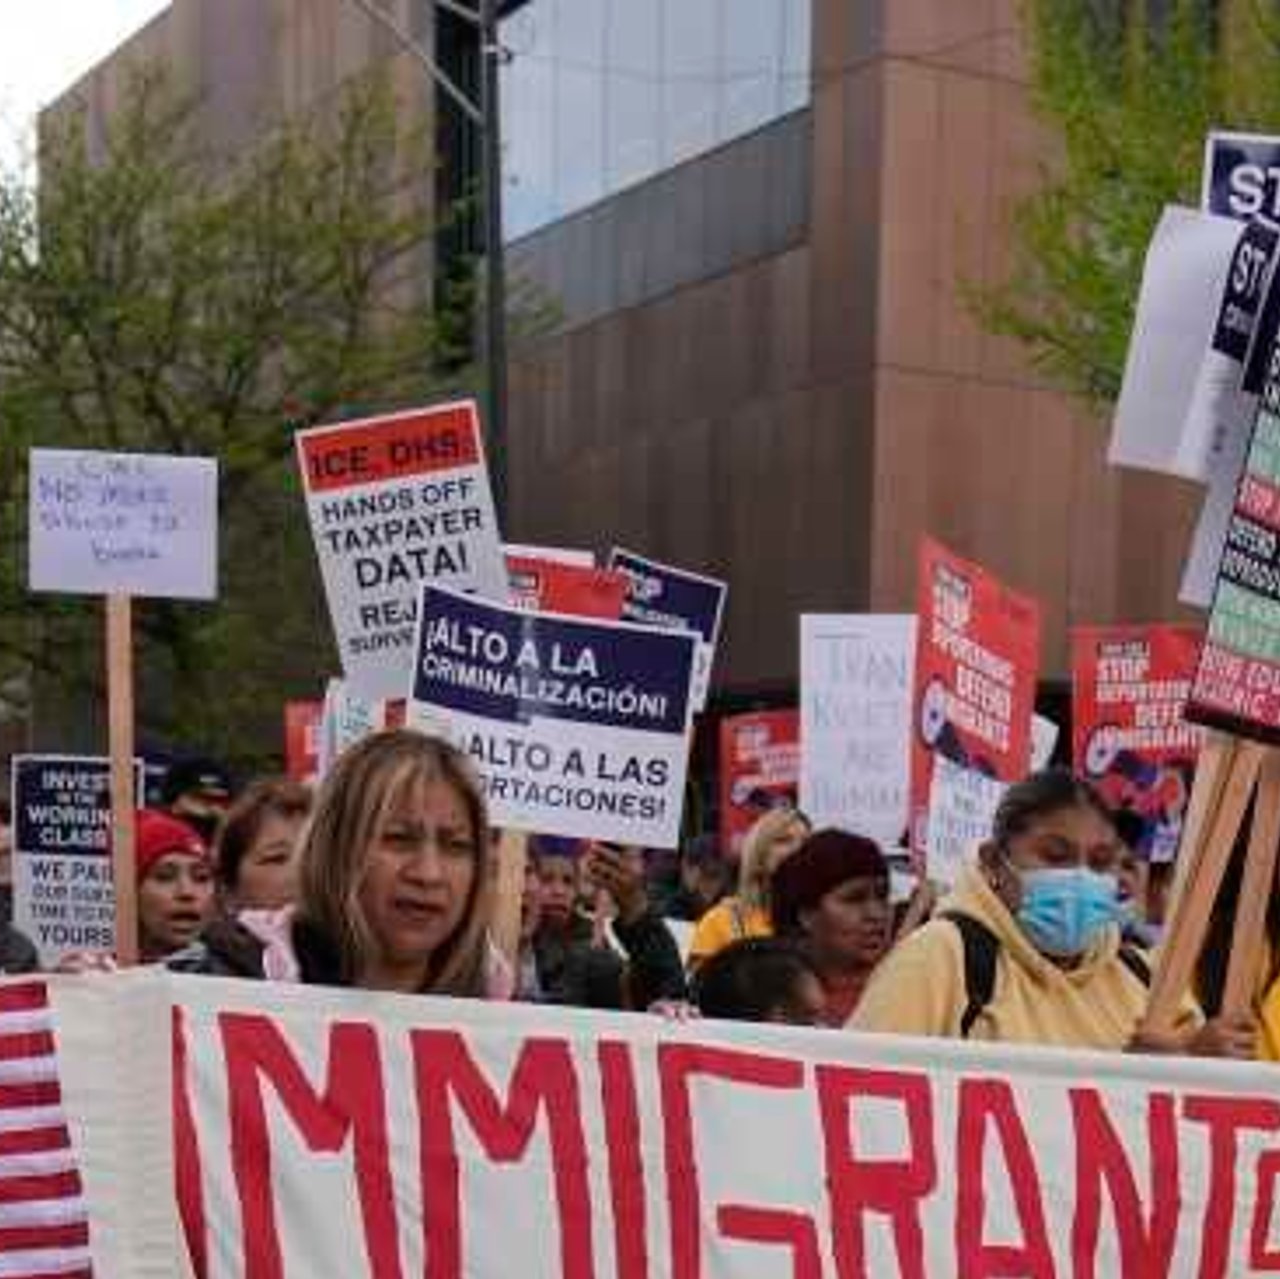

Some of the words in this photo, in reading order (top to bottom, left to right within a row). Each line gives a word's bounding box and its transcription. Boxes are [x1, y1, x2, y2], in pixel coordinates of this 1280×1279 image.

[321, 487, 414, 524] HANDS
[422, 477, 474, 505] OFF
[325, 509, 482, 551] TAXPAYER
[354, 541, 467, 589] DATA!
[359, 600, 418, 628] REJ
[516, 639, 540, 669] A
[551, 644, 598, 677] LA
[421, 653, 667, 719] CRIMINALIZACIÓN!
[562, 750, 586, 777] A
[597, 753, 670, 787] LAS
[27, 806, 114, 825] WORKIN
[39, 827, 108, 846] CLASS
[32, 862, 65, 881] WE
